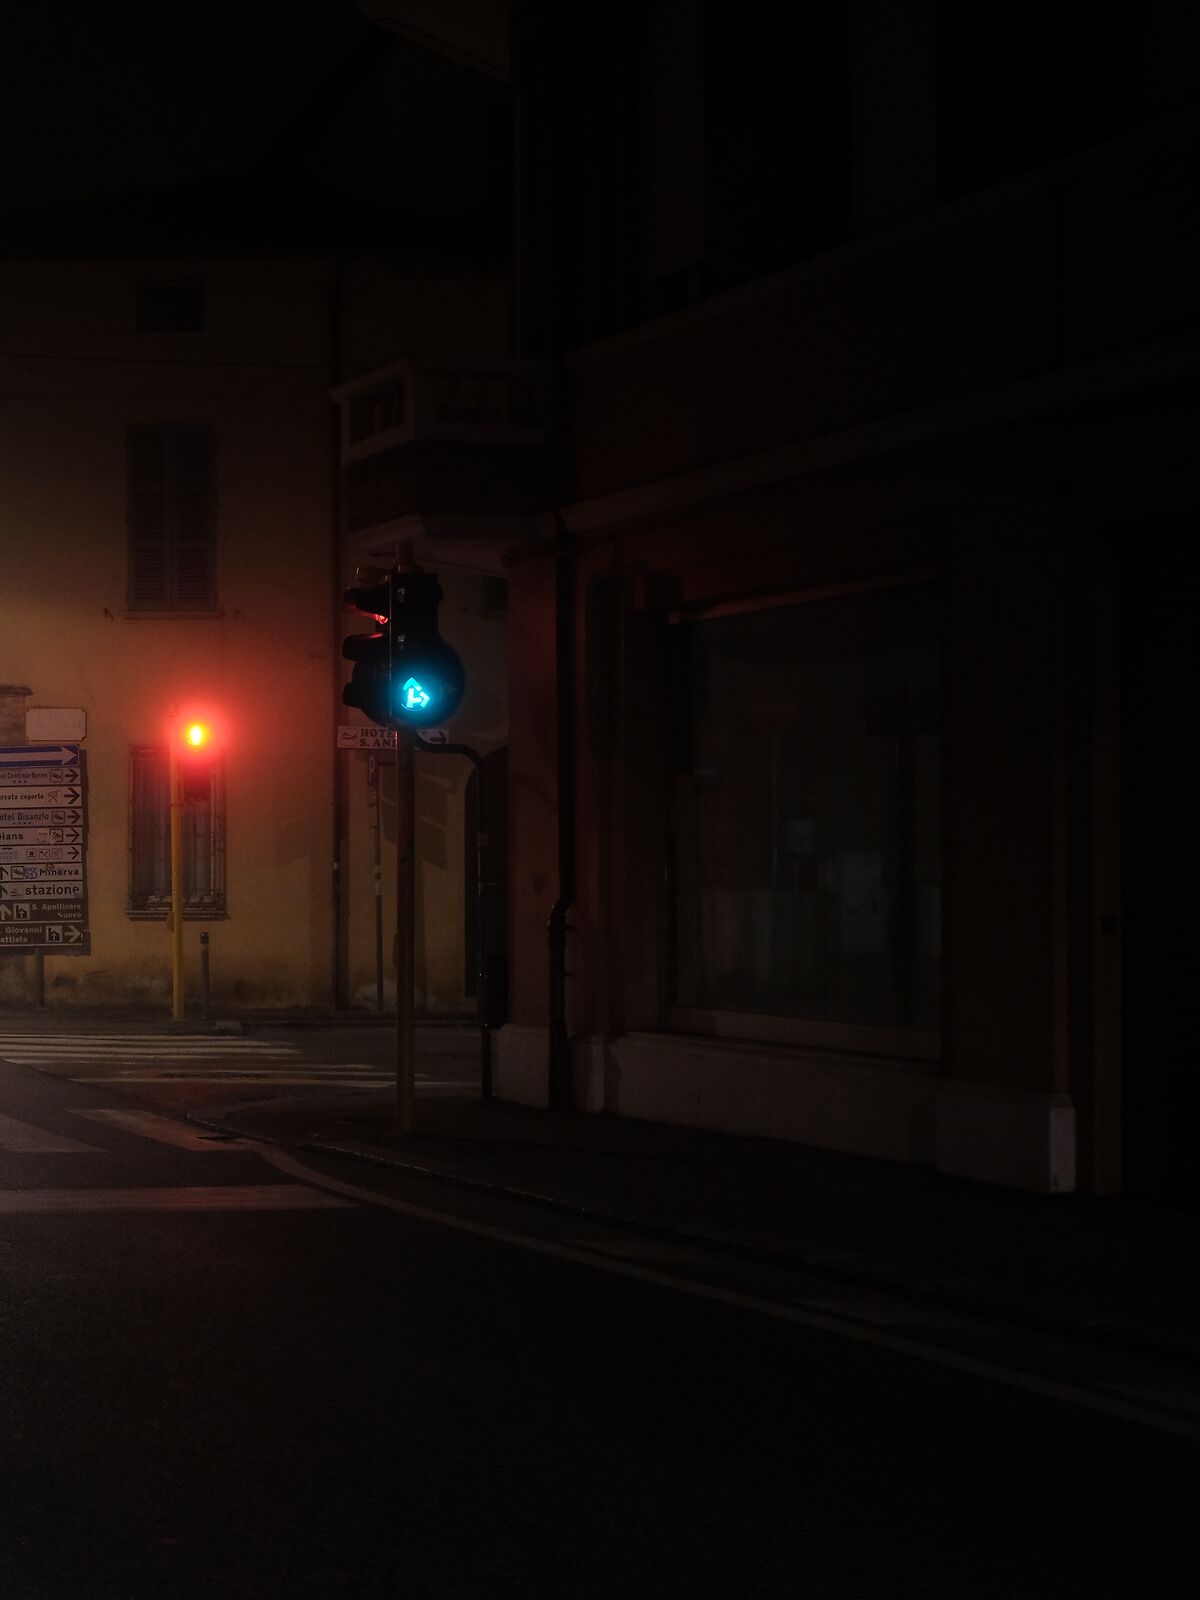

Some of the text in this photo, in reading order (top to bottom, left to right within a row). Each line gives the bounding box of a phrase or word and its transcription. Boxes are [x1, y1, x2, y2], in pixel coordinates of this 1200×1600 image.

[39, 868, 79, 876] Minerva
[25, 885, 80, 895] stazione
[42, 903, 81, 911] Apollinare
[5, 926, 42, 934] Giovanni
